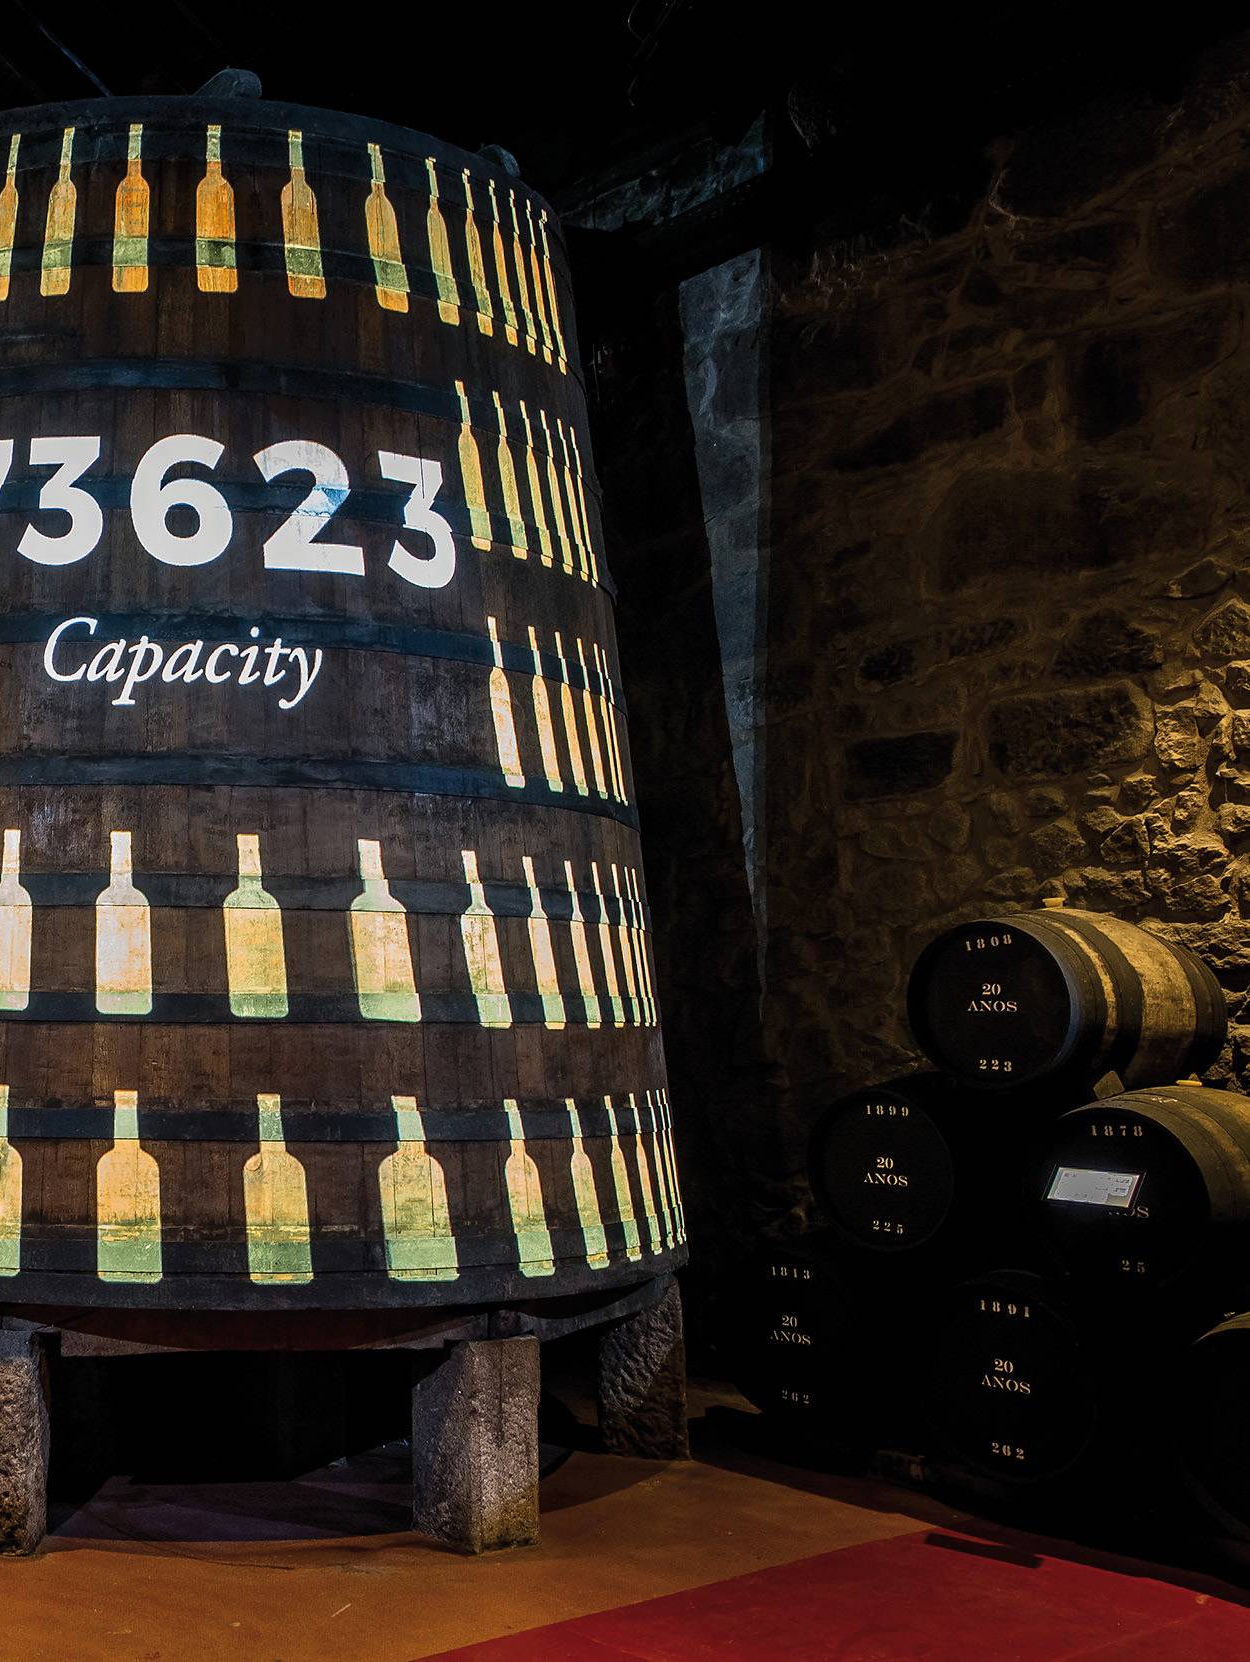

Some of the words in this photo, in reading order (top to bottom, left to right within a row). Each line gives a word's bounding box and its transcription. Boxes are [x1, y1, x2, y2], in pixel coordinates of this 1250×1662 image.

[42, 616, 324, 710] Capacity
[965, 932, 1013, 951] 1808
[981, 983, 1002, 997] 20
[966, 1000, 1019, 1014] ANOS
[978, 1059, 1013, 1072] 223
[1091, 1124, 1143, 1137] 1878
[876, 1156, 895, 1170] 20
[863, 1172, 909, 1188] ANOS
[781, 1315, 798, 1327] 20
[769, 1330, 812, 1345] ANOS
[993, 1358, 1015, 1373] 20
[981, 1374, 1032, 1395] ANOS
